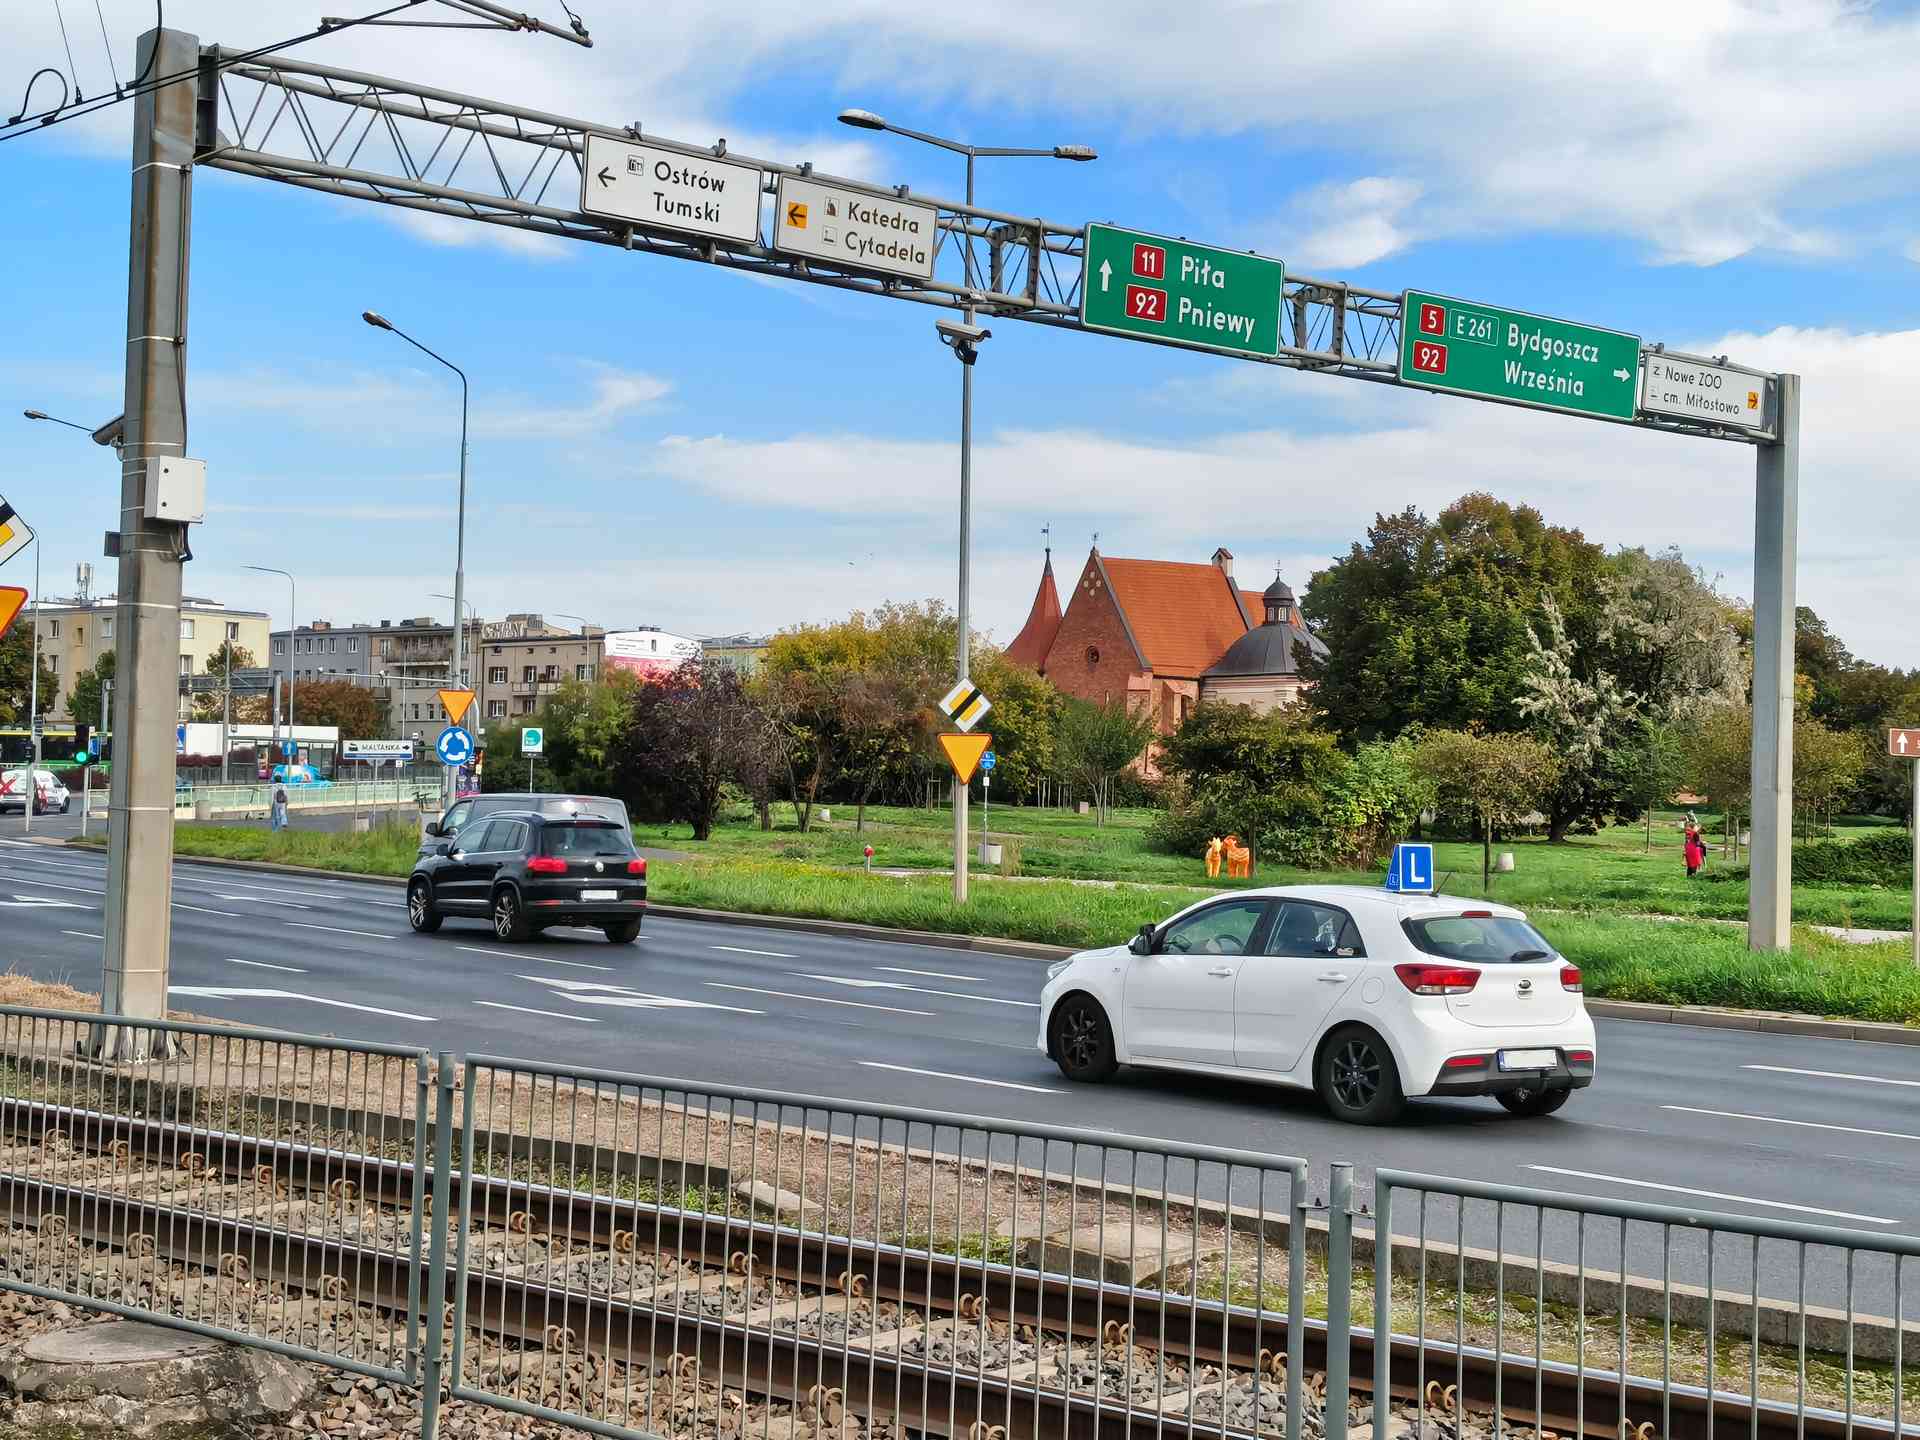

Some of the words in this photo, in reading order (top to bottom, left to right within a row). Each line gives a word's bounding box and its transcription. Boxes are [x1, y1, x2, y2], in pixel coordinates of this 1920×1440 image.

[654, 161, 725, 192] Ostrów
[653, 191, 720, 223] Tumski
[848, 201, 919, 233] Katedra
[845, 231, 925, 264] Cytadela
[1142, 251, 1156, 273] 11
[1181, 255, 1225, 289] Piła
[1135, 292, 1157, 315] 92
[1178, 296, 1256, 343] Pniewy
[1427, 311, 1438, 329] 5
[1456, 316, 1465, 335] E
[1468, 320, 1492, 340] 261
[1420, 347, 1441, 368] 92
[1507, 323, 1600, 363] Bydgoszcz
[1504, 359, 1585, 396] Września
[1665, 366, 1695, 385] Nowe
[1698, 372, 1722, 390] ZOO
[1663, 391, 1681, 405] cm.
[1686, 392, 1740, 415] Miłostowo
[1410, 852, 1425, 883] L
